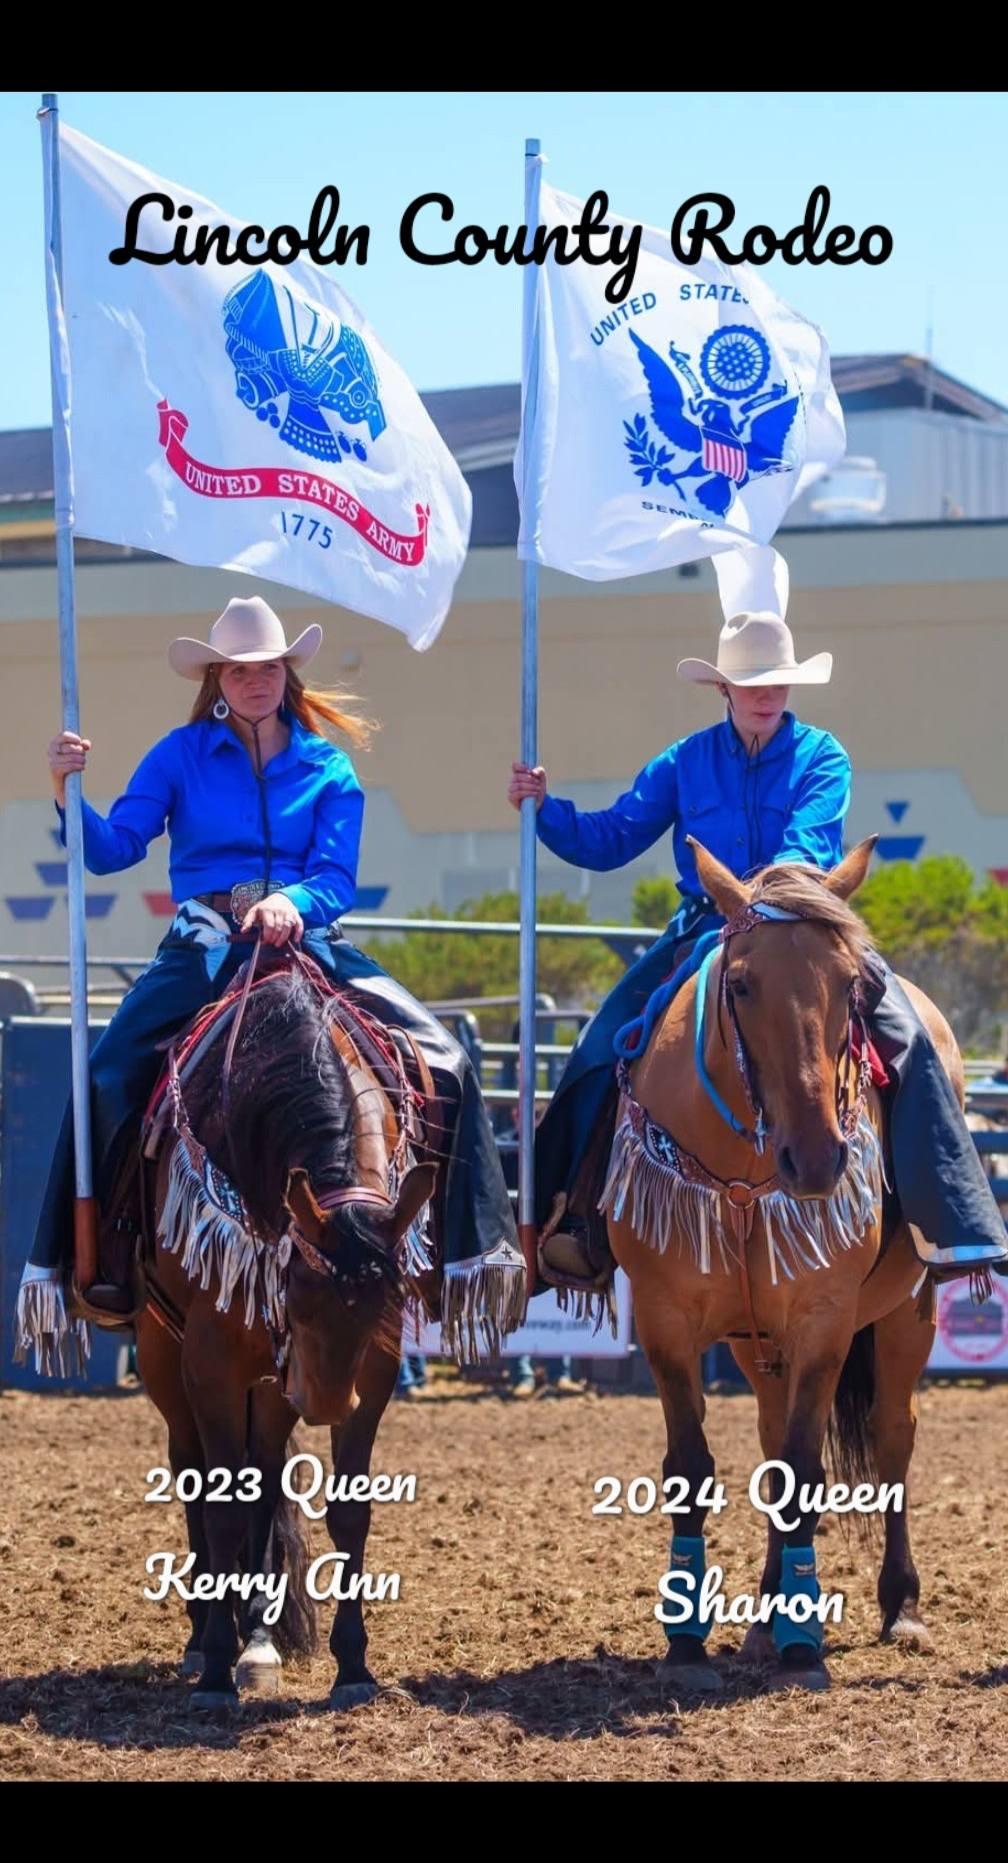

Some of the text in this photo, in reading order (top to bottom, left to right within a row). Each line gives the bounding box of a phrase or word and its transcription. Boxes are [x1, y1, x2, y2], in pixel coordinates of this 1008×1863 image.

[590, 292, 657, 346] UNITED
[184, 461, 416, 562] UNITED STATES ARMY
[281, 511, 334, 549] 1775
